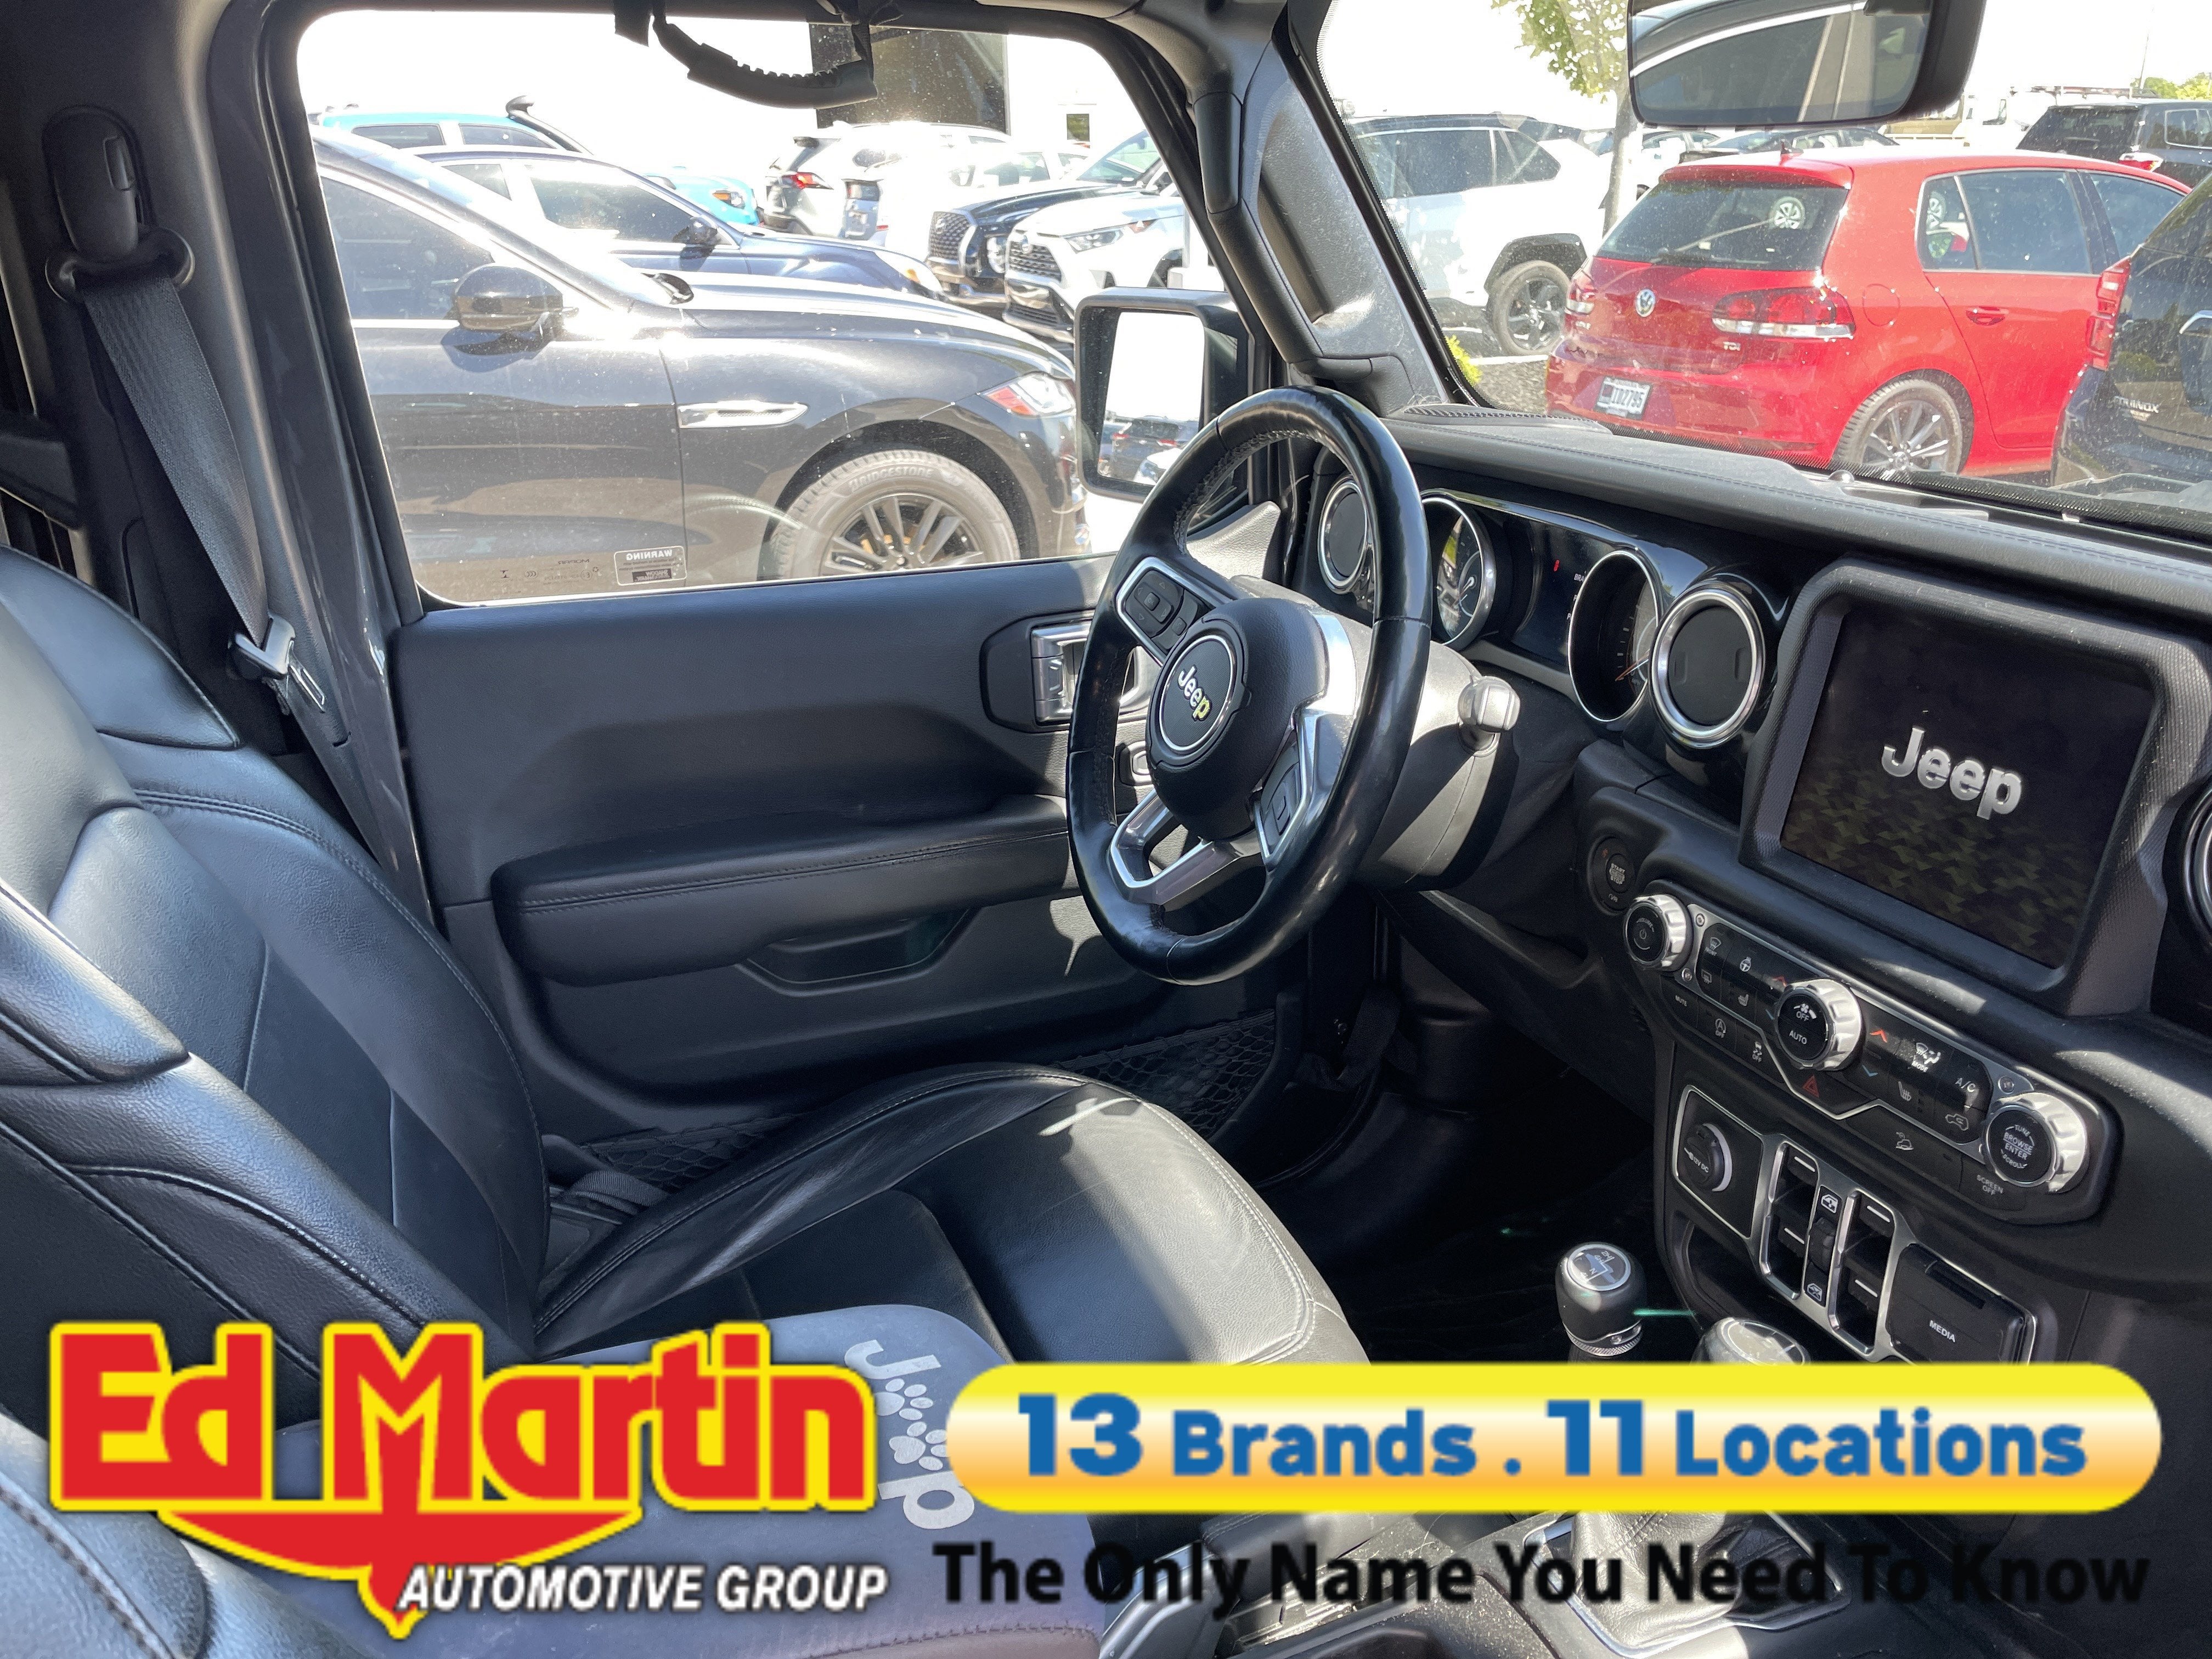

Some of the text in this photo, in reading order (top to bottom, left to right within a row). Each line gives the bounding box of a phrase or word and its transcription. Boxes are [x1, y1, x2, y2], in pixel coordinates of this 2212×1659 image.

[1178, 664, 1212, 721] Jeep
[1881, 726, 2022, 820] Jeep
[1675, 995, 1687, 1007] MUTE
[1796, 1011, 1809, 1022] OFF
[1789, 1030, 1807, 1045] AUTO
[1911, 1060, 1928, 1073] MODE
[1955, 1077, 1976, 1092] A/C
[2015, 1125, 2030, 1137] TUNE
[2004, 1132, 2033, 1153] BROWSE
[2005, 1143, 2027, 1160] ENTER
[1701, 1163, 1709, 1173] DC
[2002, 1154, 2024, 1169] SCROLL
[1977, 1175, 2003, 1194] SCREEN
[1982, 1185, 1996, 1195] OFF
[1929, 1320, 1955, 1342] MEDIA
